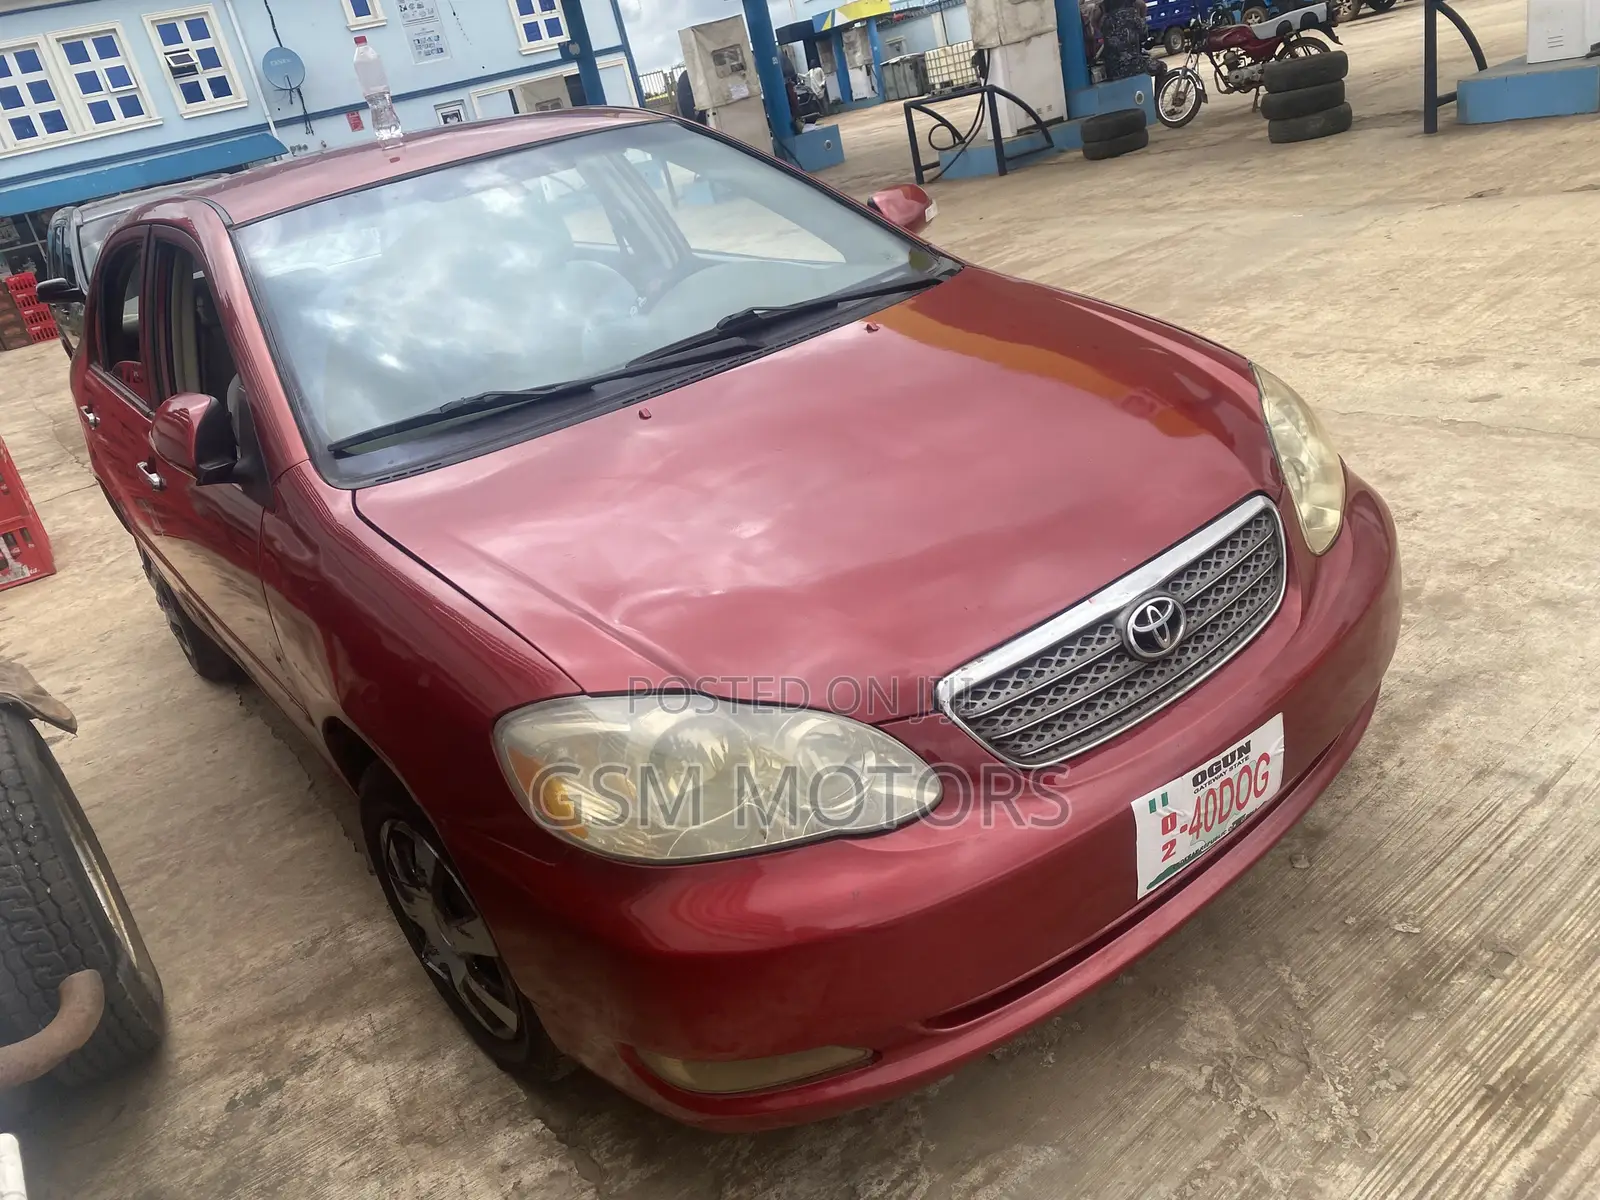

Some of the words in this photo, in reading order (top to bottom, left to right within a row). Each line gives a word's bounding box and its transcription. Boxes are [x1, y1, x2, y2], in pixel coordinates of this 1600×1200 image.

[1192, 740, 1251, 787] OGUN
[1194, 769, 1227, 794] GATEWAY
[1229, 755, 1250, 772] STATE
